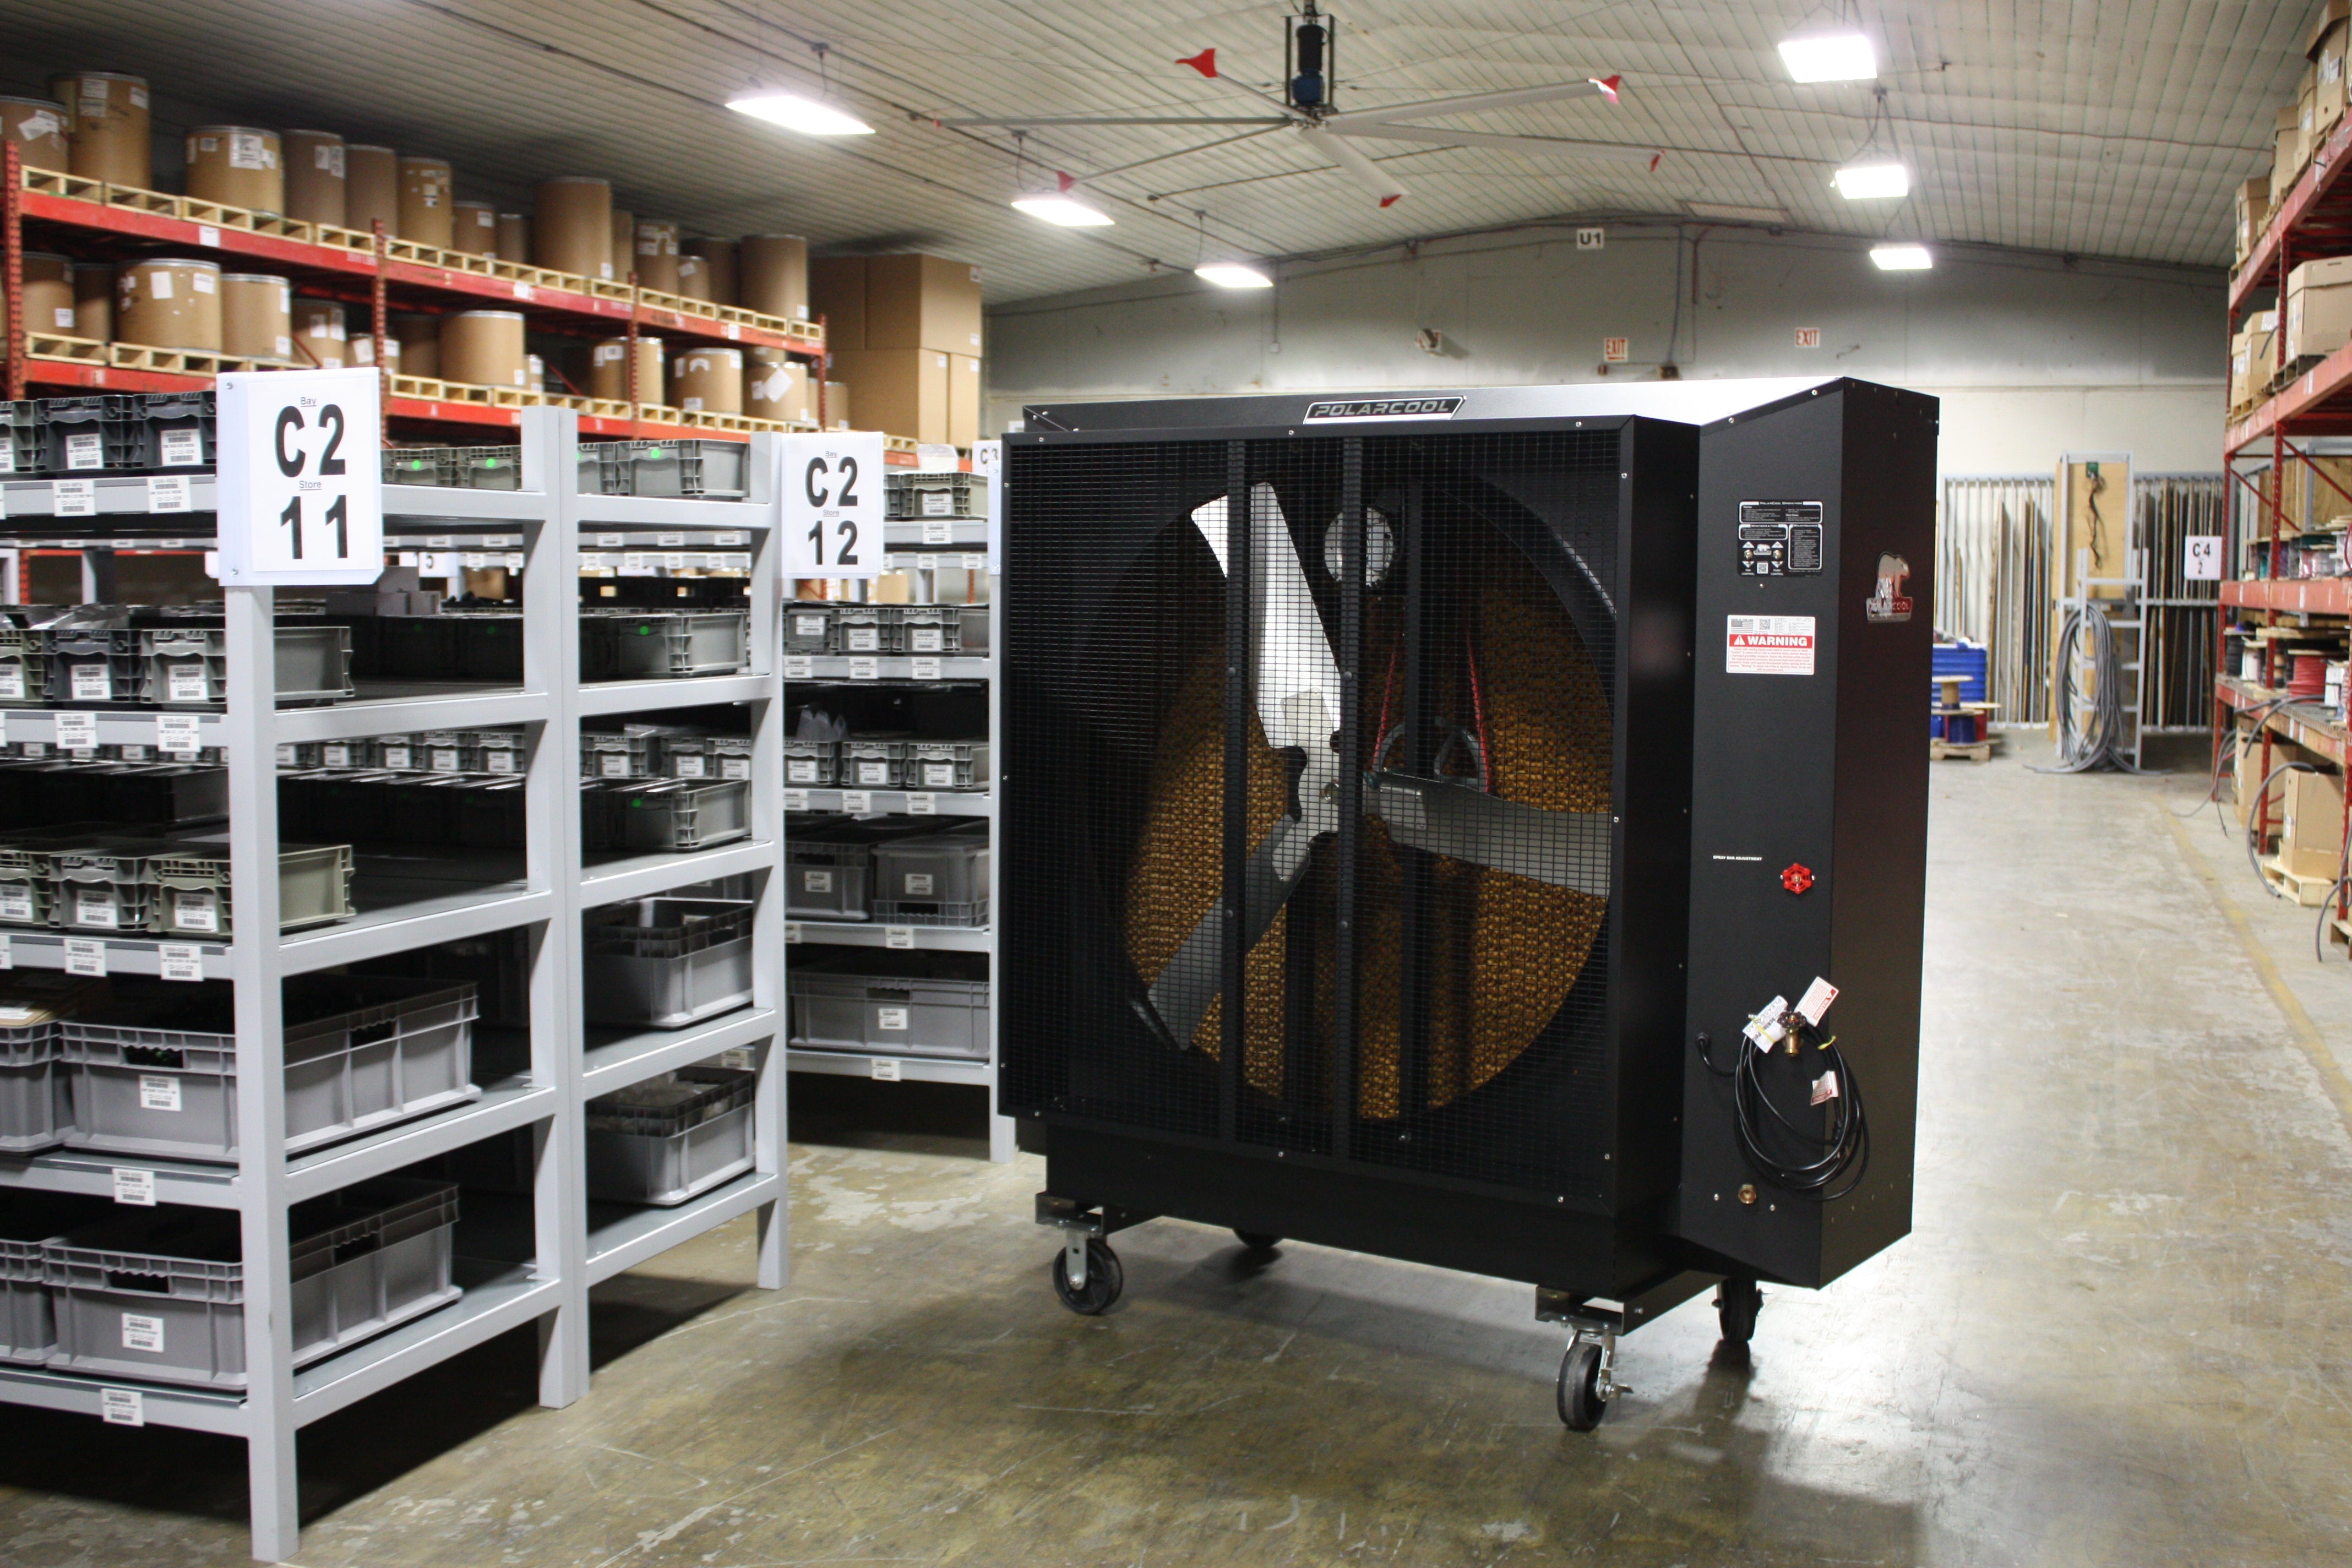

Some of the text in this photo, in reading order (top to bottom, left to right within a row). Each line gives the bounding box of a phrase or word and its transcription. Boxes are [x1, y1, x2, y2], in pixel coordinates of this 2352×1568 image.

[1580, 232, 1600, 246] U1
[1796, 330, 1818, 346] EXIT
[1606, 339, 1625, 355] EXIT
[300, 397, 317, 405] Bay
[1314, 400, 1449, 417] POLARCOOL
[299, 480, 322, 489] Store
[1747, 636, 1807, 646] WARNING
[1762, 998, 1782, 1019] PLEASE
